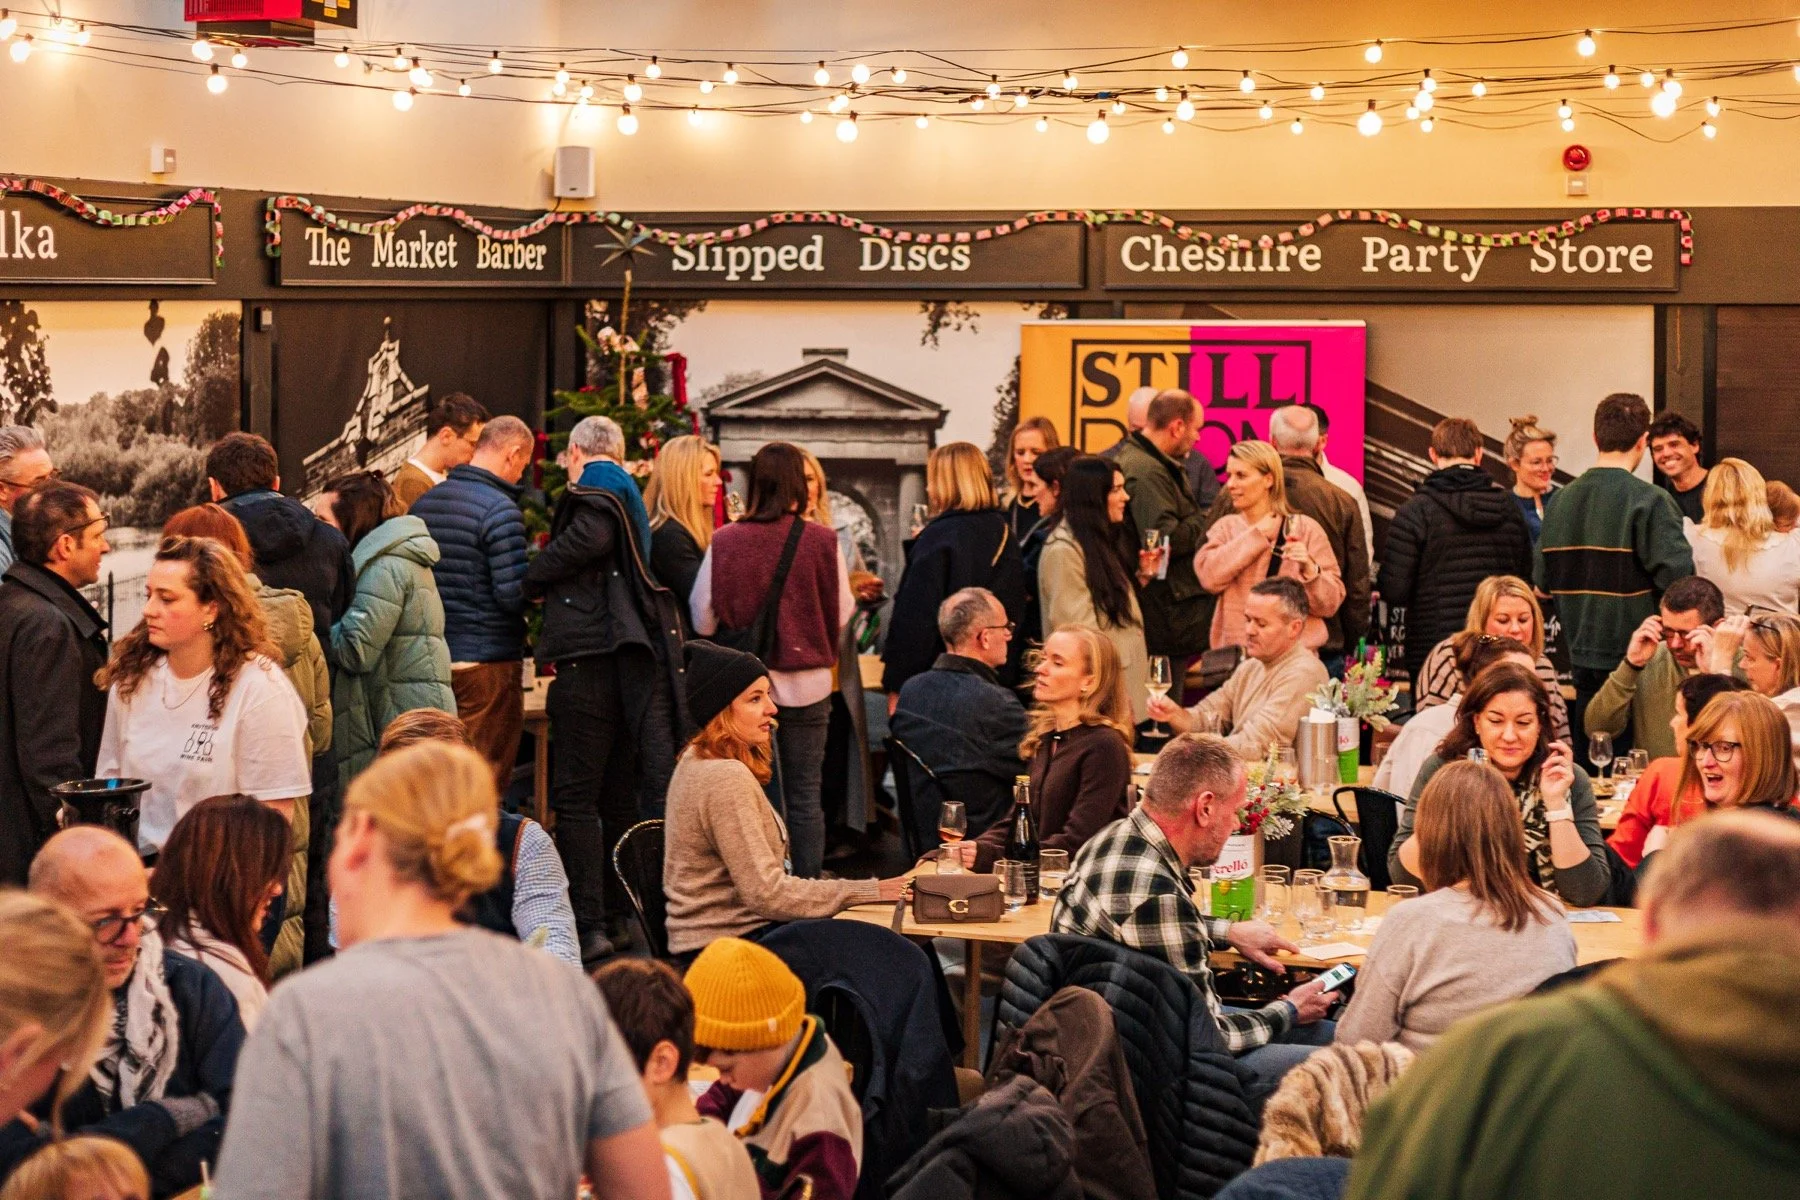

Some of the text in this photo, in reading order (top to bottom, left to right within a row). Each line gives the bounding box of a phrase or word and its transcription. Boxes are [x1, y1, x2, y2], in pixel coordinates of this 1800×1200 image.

[304, 227, 547, 270] The Market Barber
[671, 234, 971, 281] Slipped Discs
[1361, 236, 1490, 283] Party
[1530, 236, 1653, 273] Store
[1081, 351, 1296, 409] STILL
